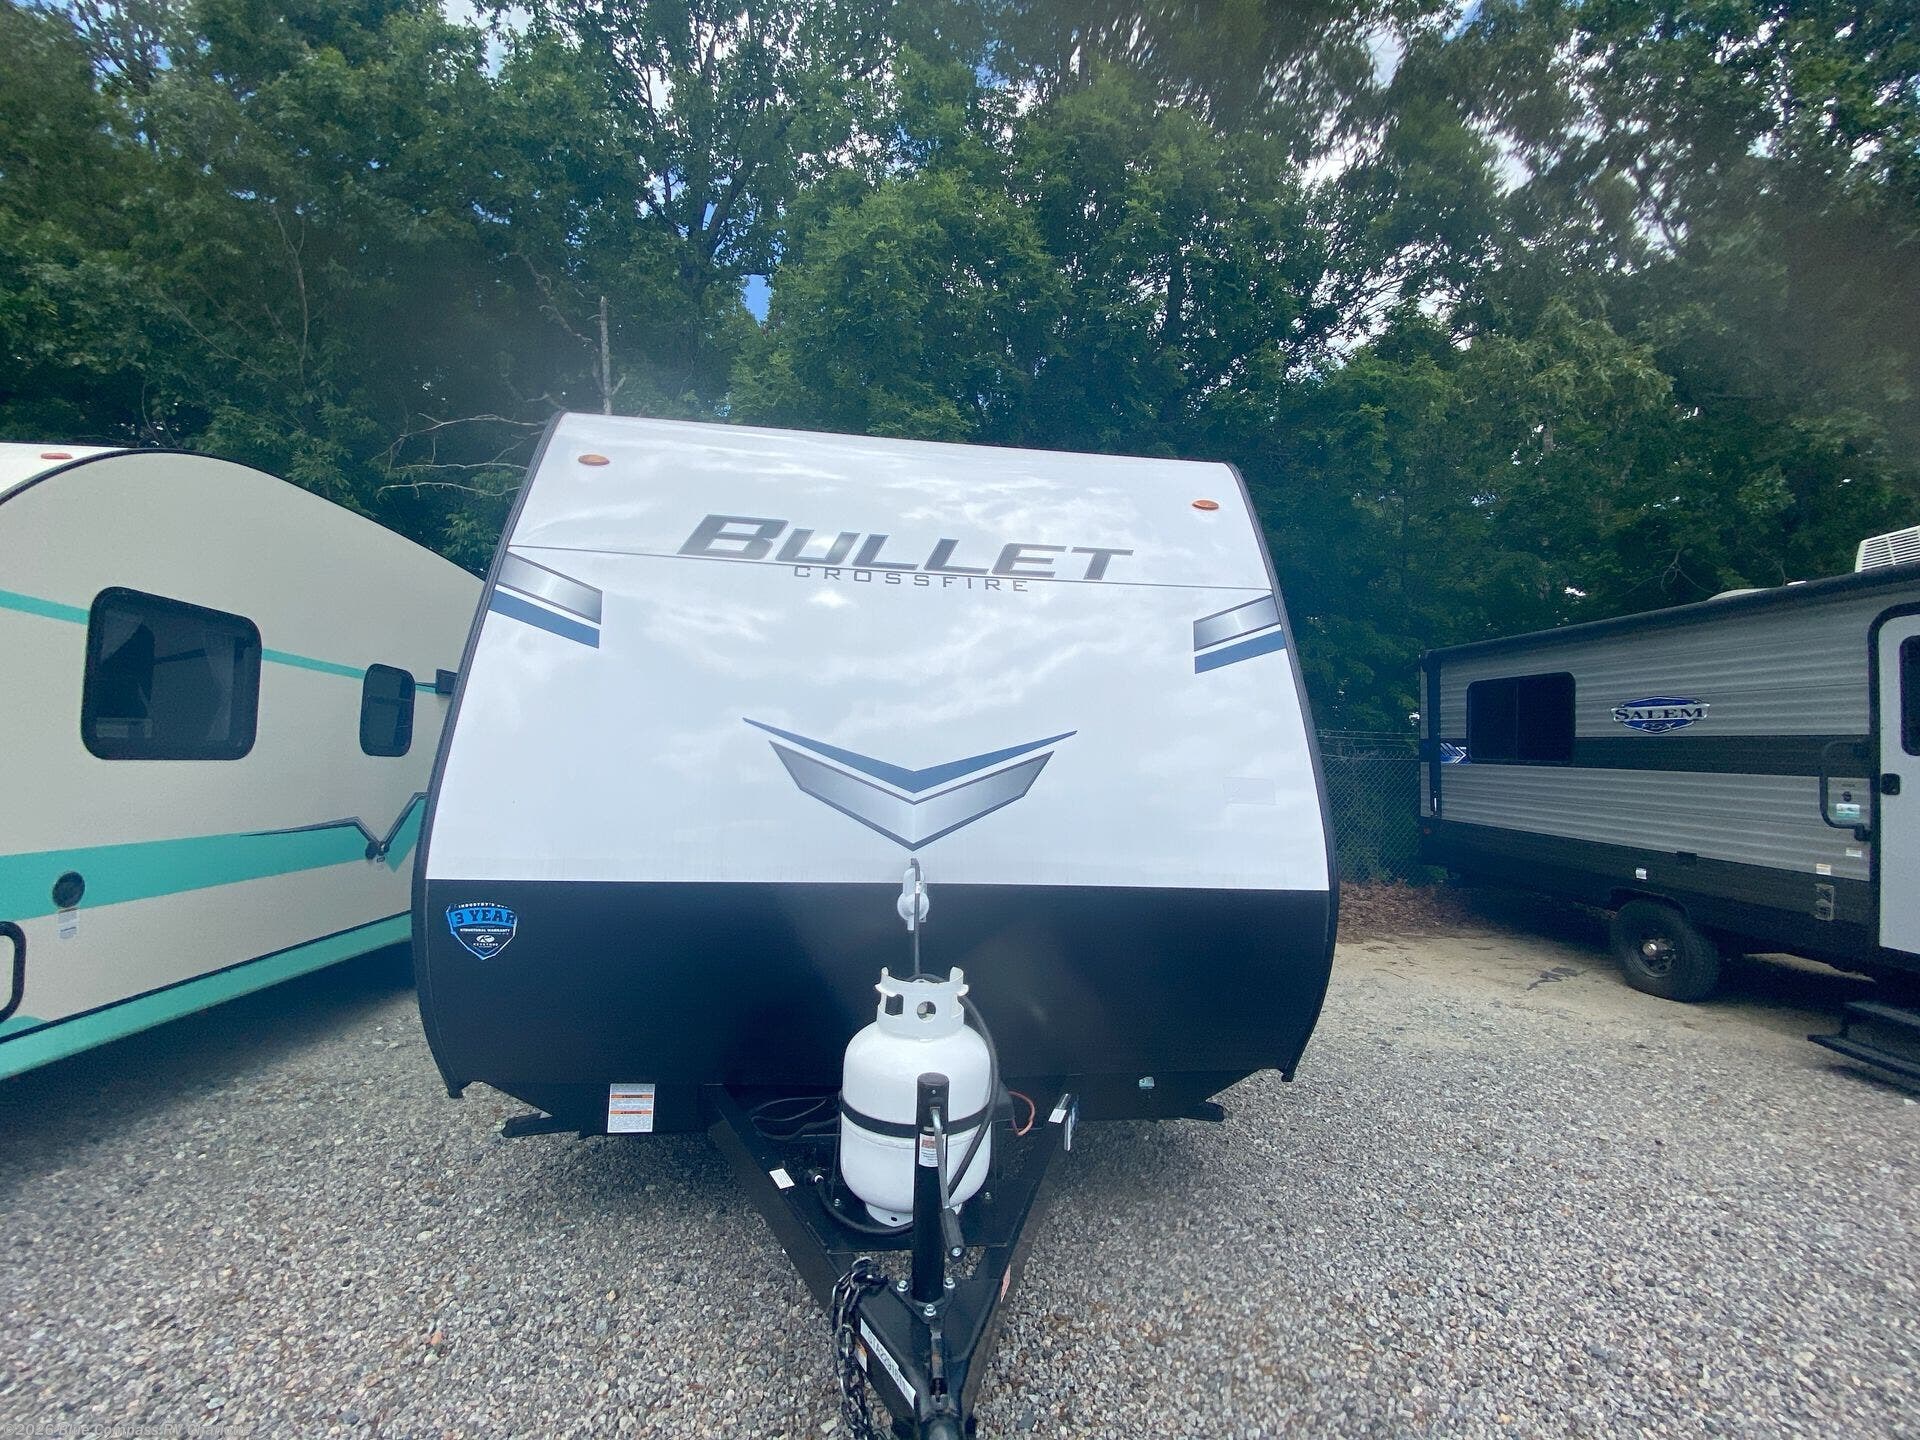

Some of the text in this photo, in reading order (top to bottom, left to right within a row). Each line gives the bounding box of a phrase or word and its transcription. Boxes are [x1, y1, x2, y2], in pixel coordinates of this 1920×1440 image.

[677, 514, 1134, 581] BULLET
[794, 565, 1028, 592] CROSSFIRE
[1615, 707, 1703, 720] SALEM
[454, 910, 515, 925] 3 YEAR
